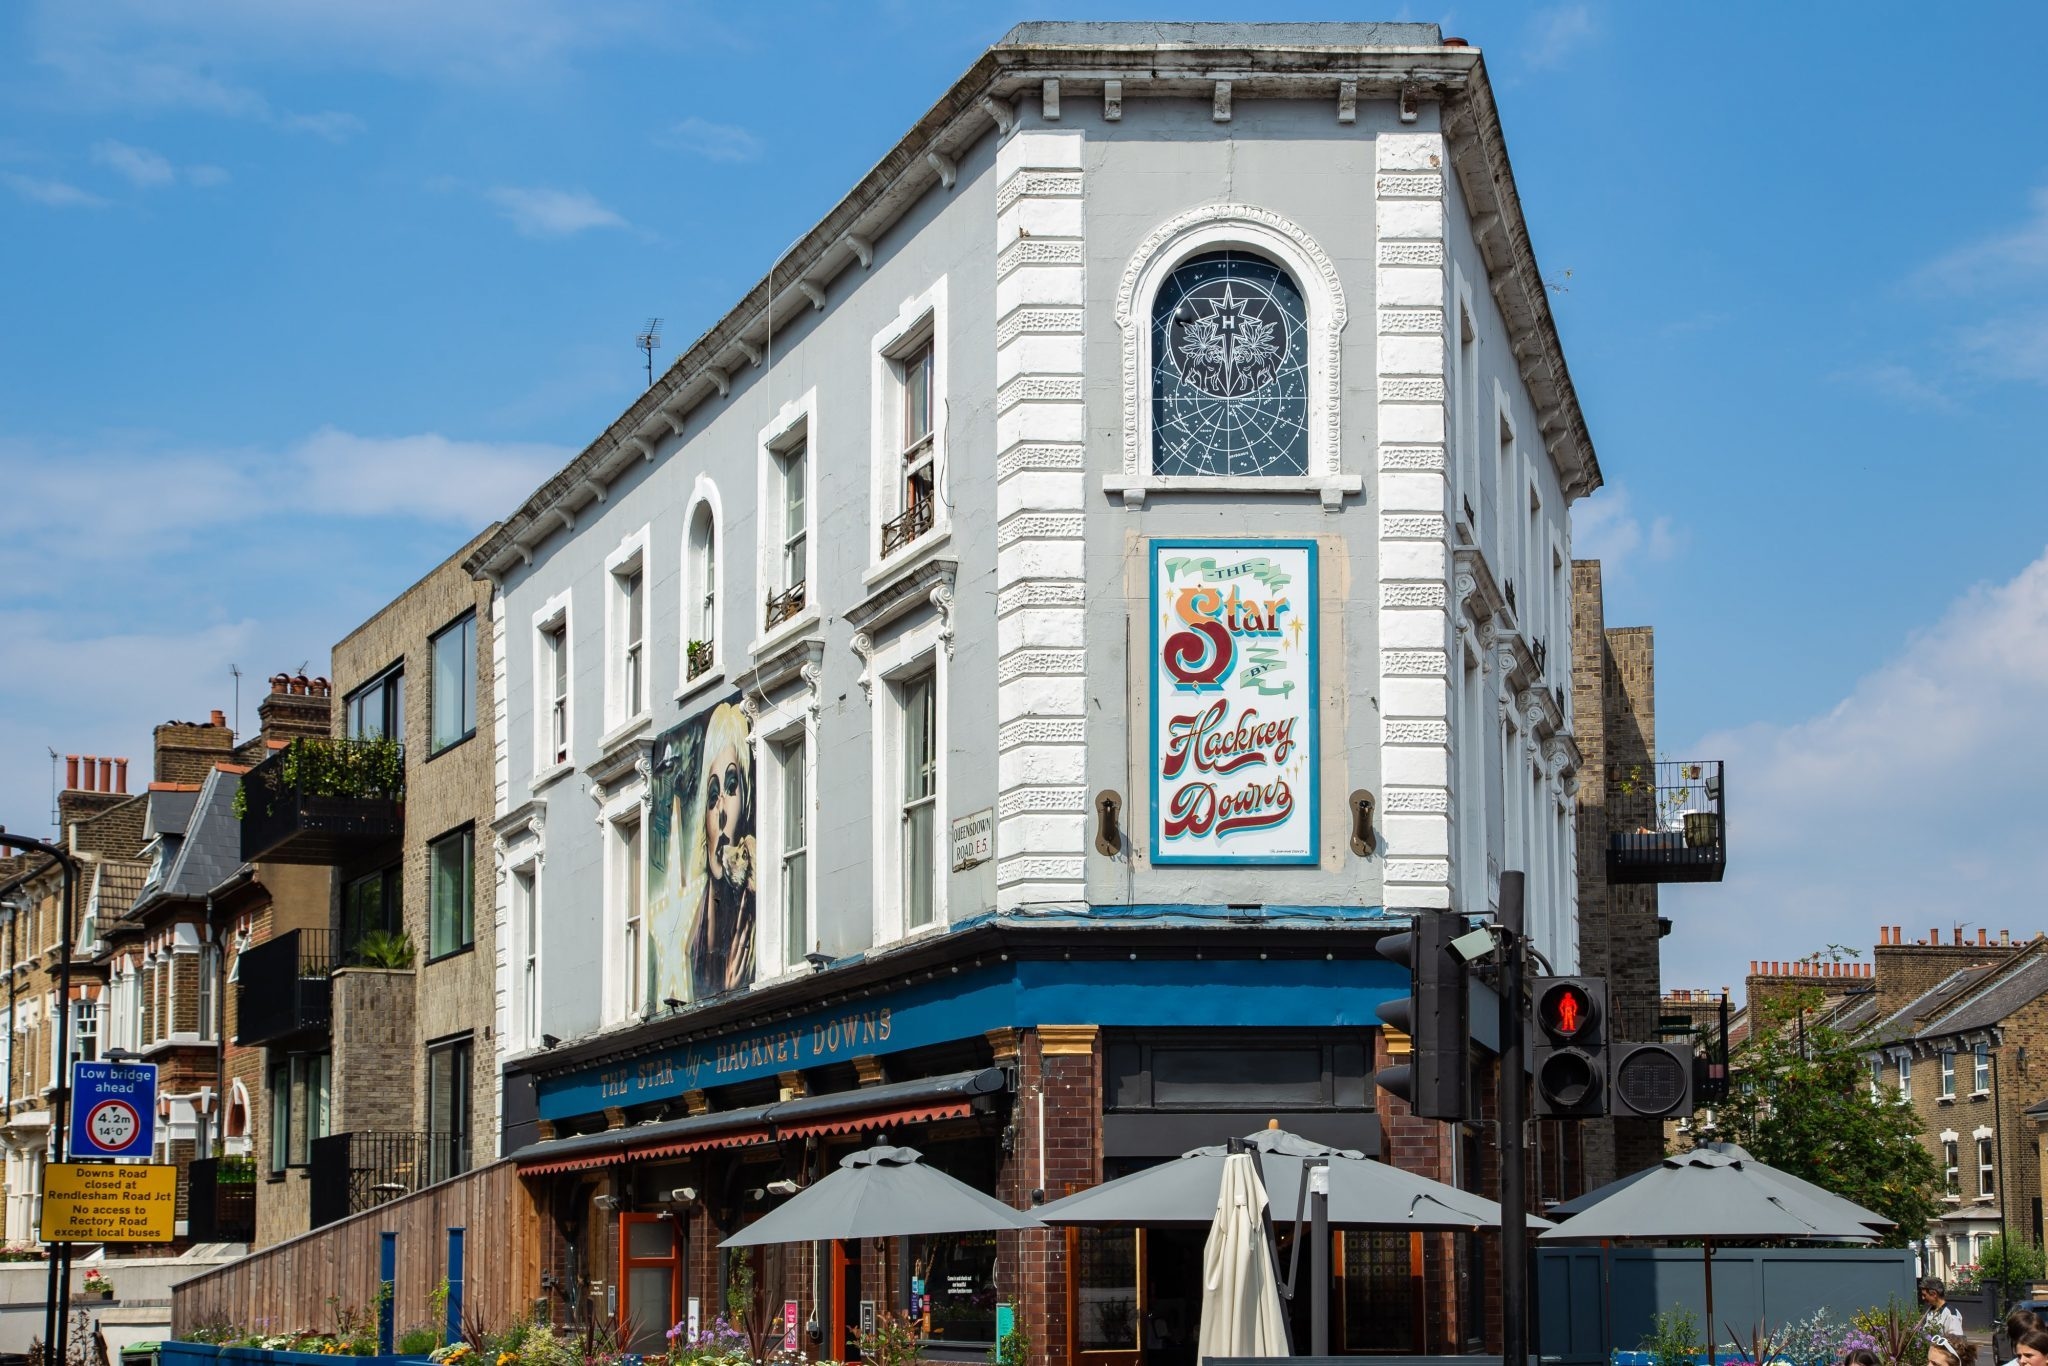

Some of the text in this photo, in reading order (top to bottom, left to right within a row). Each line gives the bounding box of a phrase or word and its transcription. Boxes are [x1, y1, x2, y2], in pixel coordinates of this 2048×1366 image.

[1222, 315, 1235, 329] H
[1215, 562, 1253, 579] THE
[1163, 584, 1291, 693] Star
[1250, 663, 1270, 677] BY
[1163, 698, 1298, 779] Hackney
[1164, 775, 1295, 845] Downs
[953, 816, 992, 843] QUEENSDOWN
[601, 1007, 892, 1098] THE STAR by HACKNEY DOWNS
[80, 1067, 151, 1082] Low bridge
[95, 1082, 134, 1093] ahead
[98, 1113, 131, 1124] 4.2m
[76, 1168, 147, 1178] Downs Road
[85, 1180, 136, 1190] closed at
[48, 1191, 172, 1201] Rendlesham Road Jct
[72, 1205, 146, 1215] No access to
[69, 1216, 148, 1227] Rectory Road
[54, 1228, 161, 1238] except local buses
